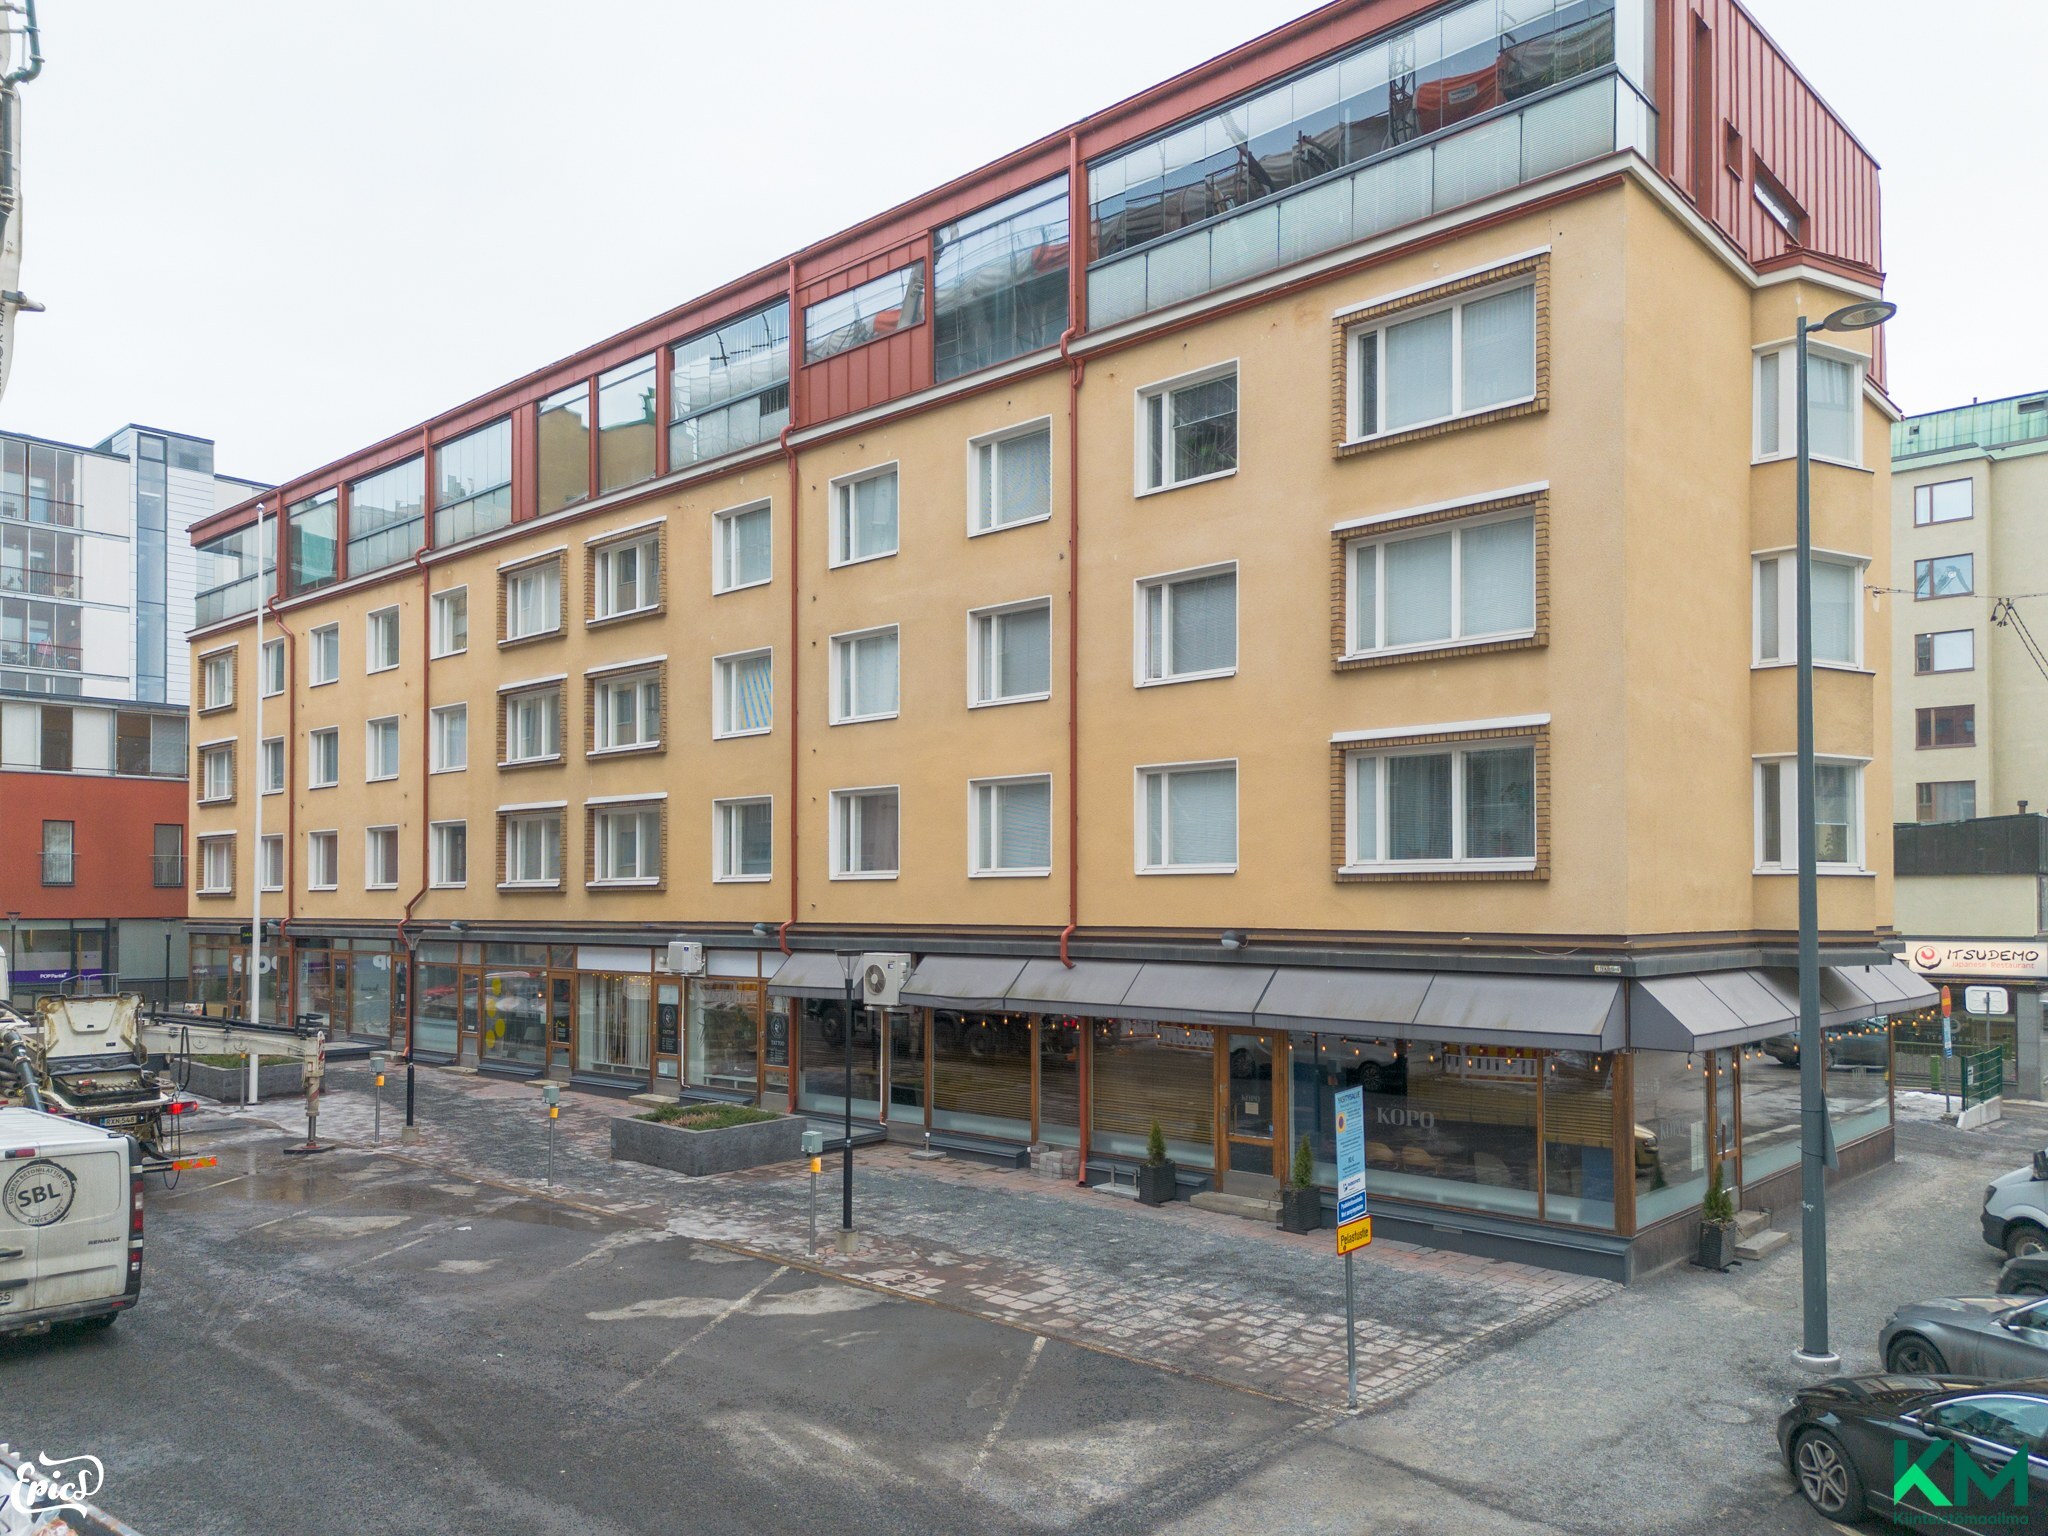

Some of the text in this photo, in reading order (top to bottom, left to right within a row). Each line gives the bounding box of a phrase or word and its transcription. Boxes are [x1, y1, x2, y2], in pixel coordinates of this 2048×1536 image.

[1947, 949, 2039, 961] ITSUDEMO
[1952, 961, 2035, 969] Japanese Restaurant
[105, 1115, 136, 1125] RXN-548
[1377, 1106, 1434, 1129] KOPO
[8, 1179, 20, 1205] SUOMEN
[18, 1183, 61, 1208] SBL
[28, 1216, 48, 1224] SINCE
[88, 1236, 121, 1246] RENAULT
[1340, 1227, 1369, 1247] Pelastustie
